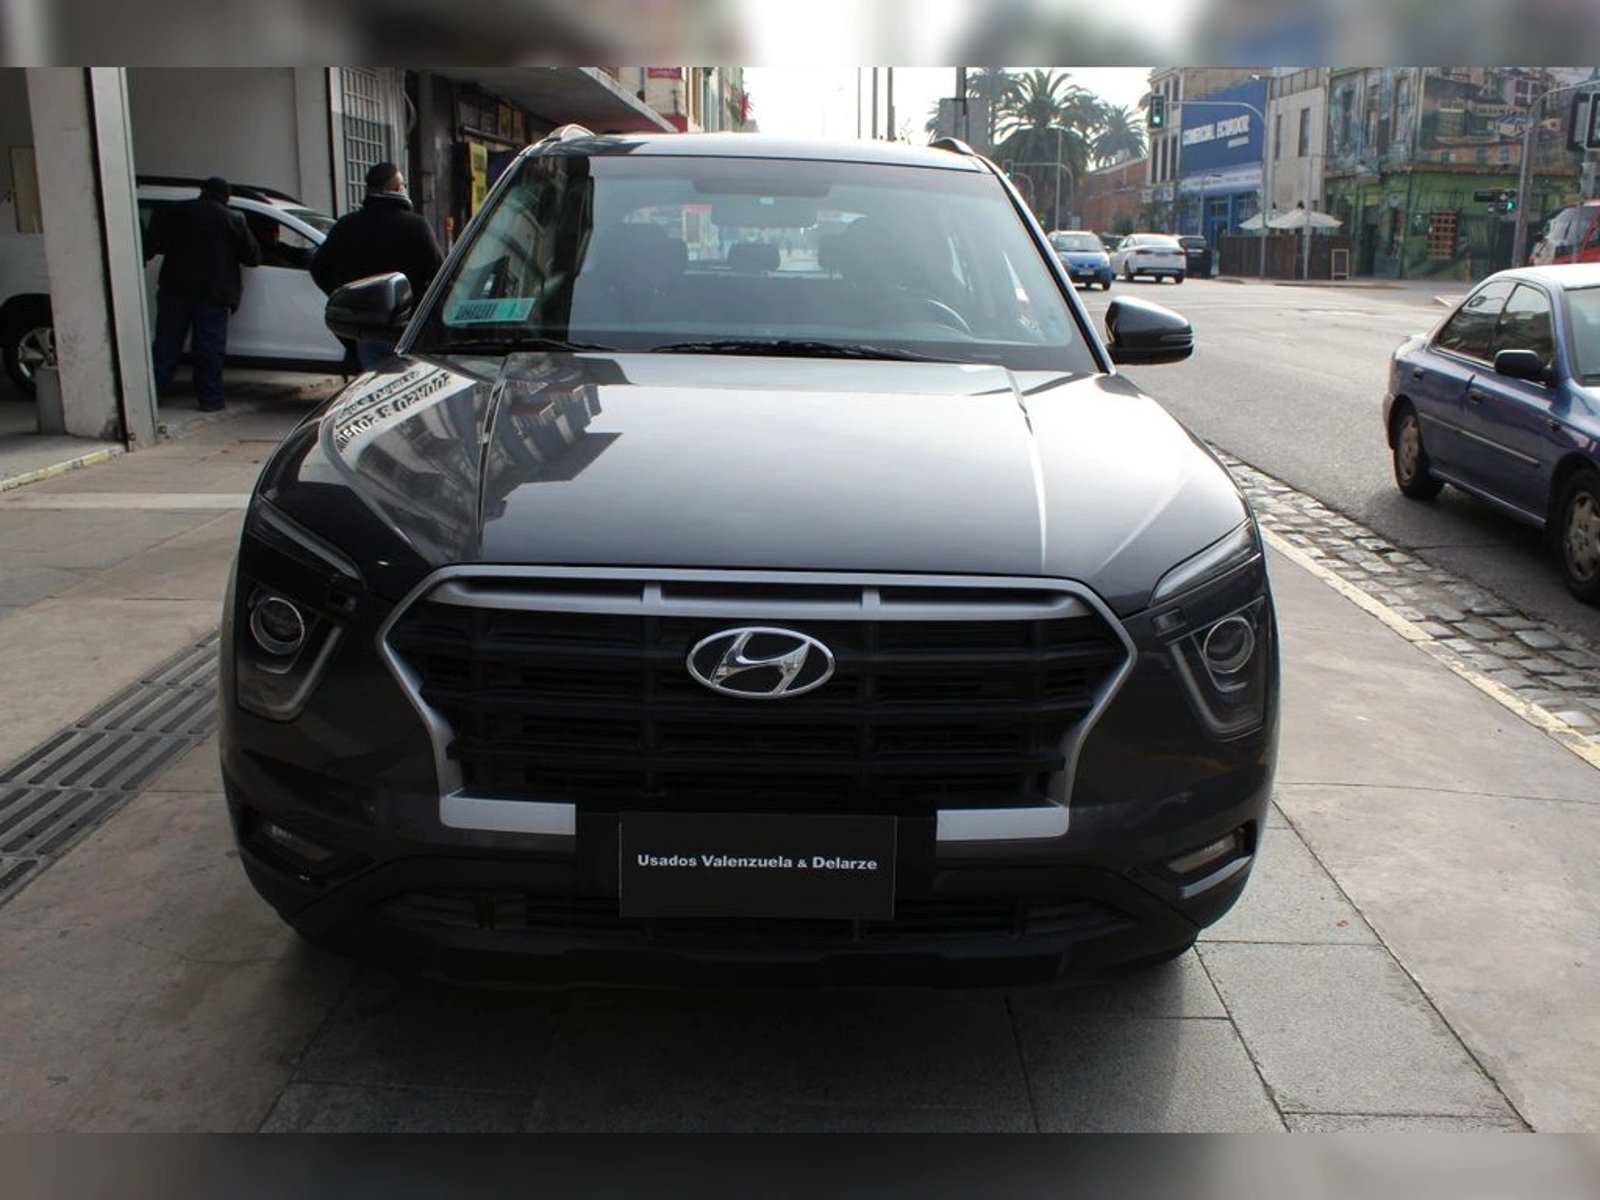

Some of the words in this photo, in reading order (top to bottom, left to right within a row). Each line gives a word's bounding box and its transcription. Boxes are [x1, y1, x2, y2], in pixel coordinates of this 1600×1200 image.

[637, 854, 697, 867] Usados
[702, 855, 792, 868] Valenzuela
[797, 858, 808, 868] &
[812, 856, 877, 870] Delarze
